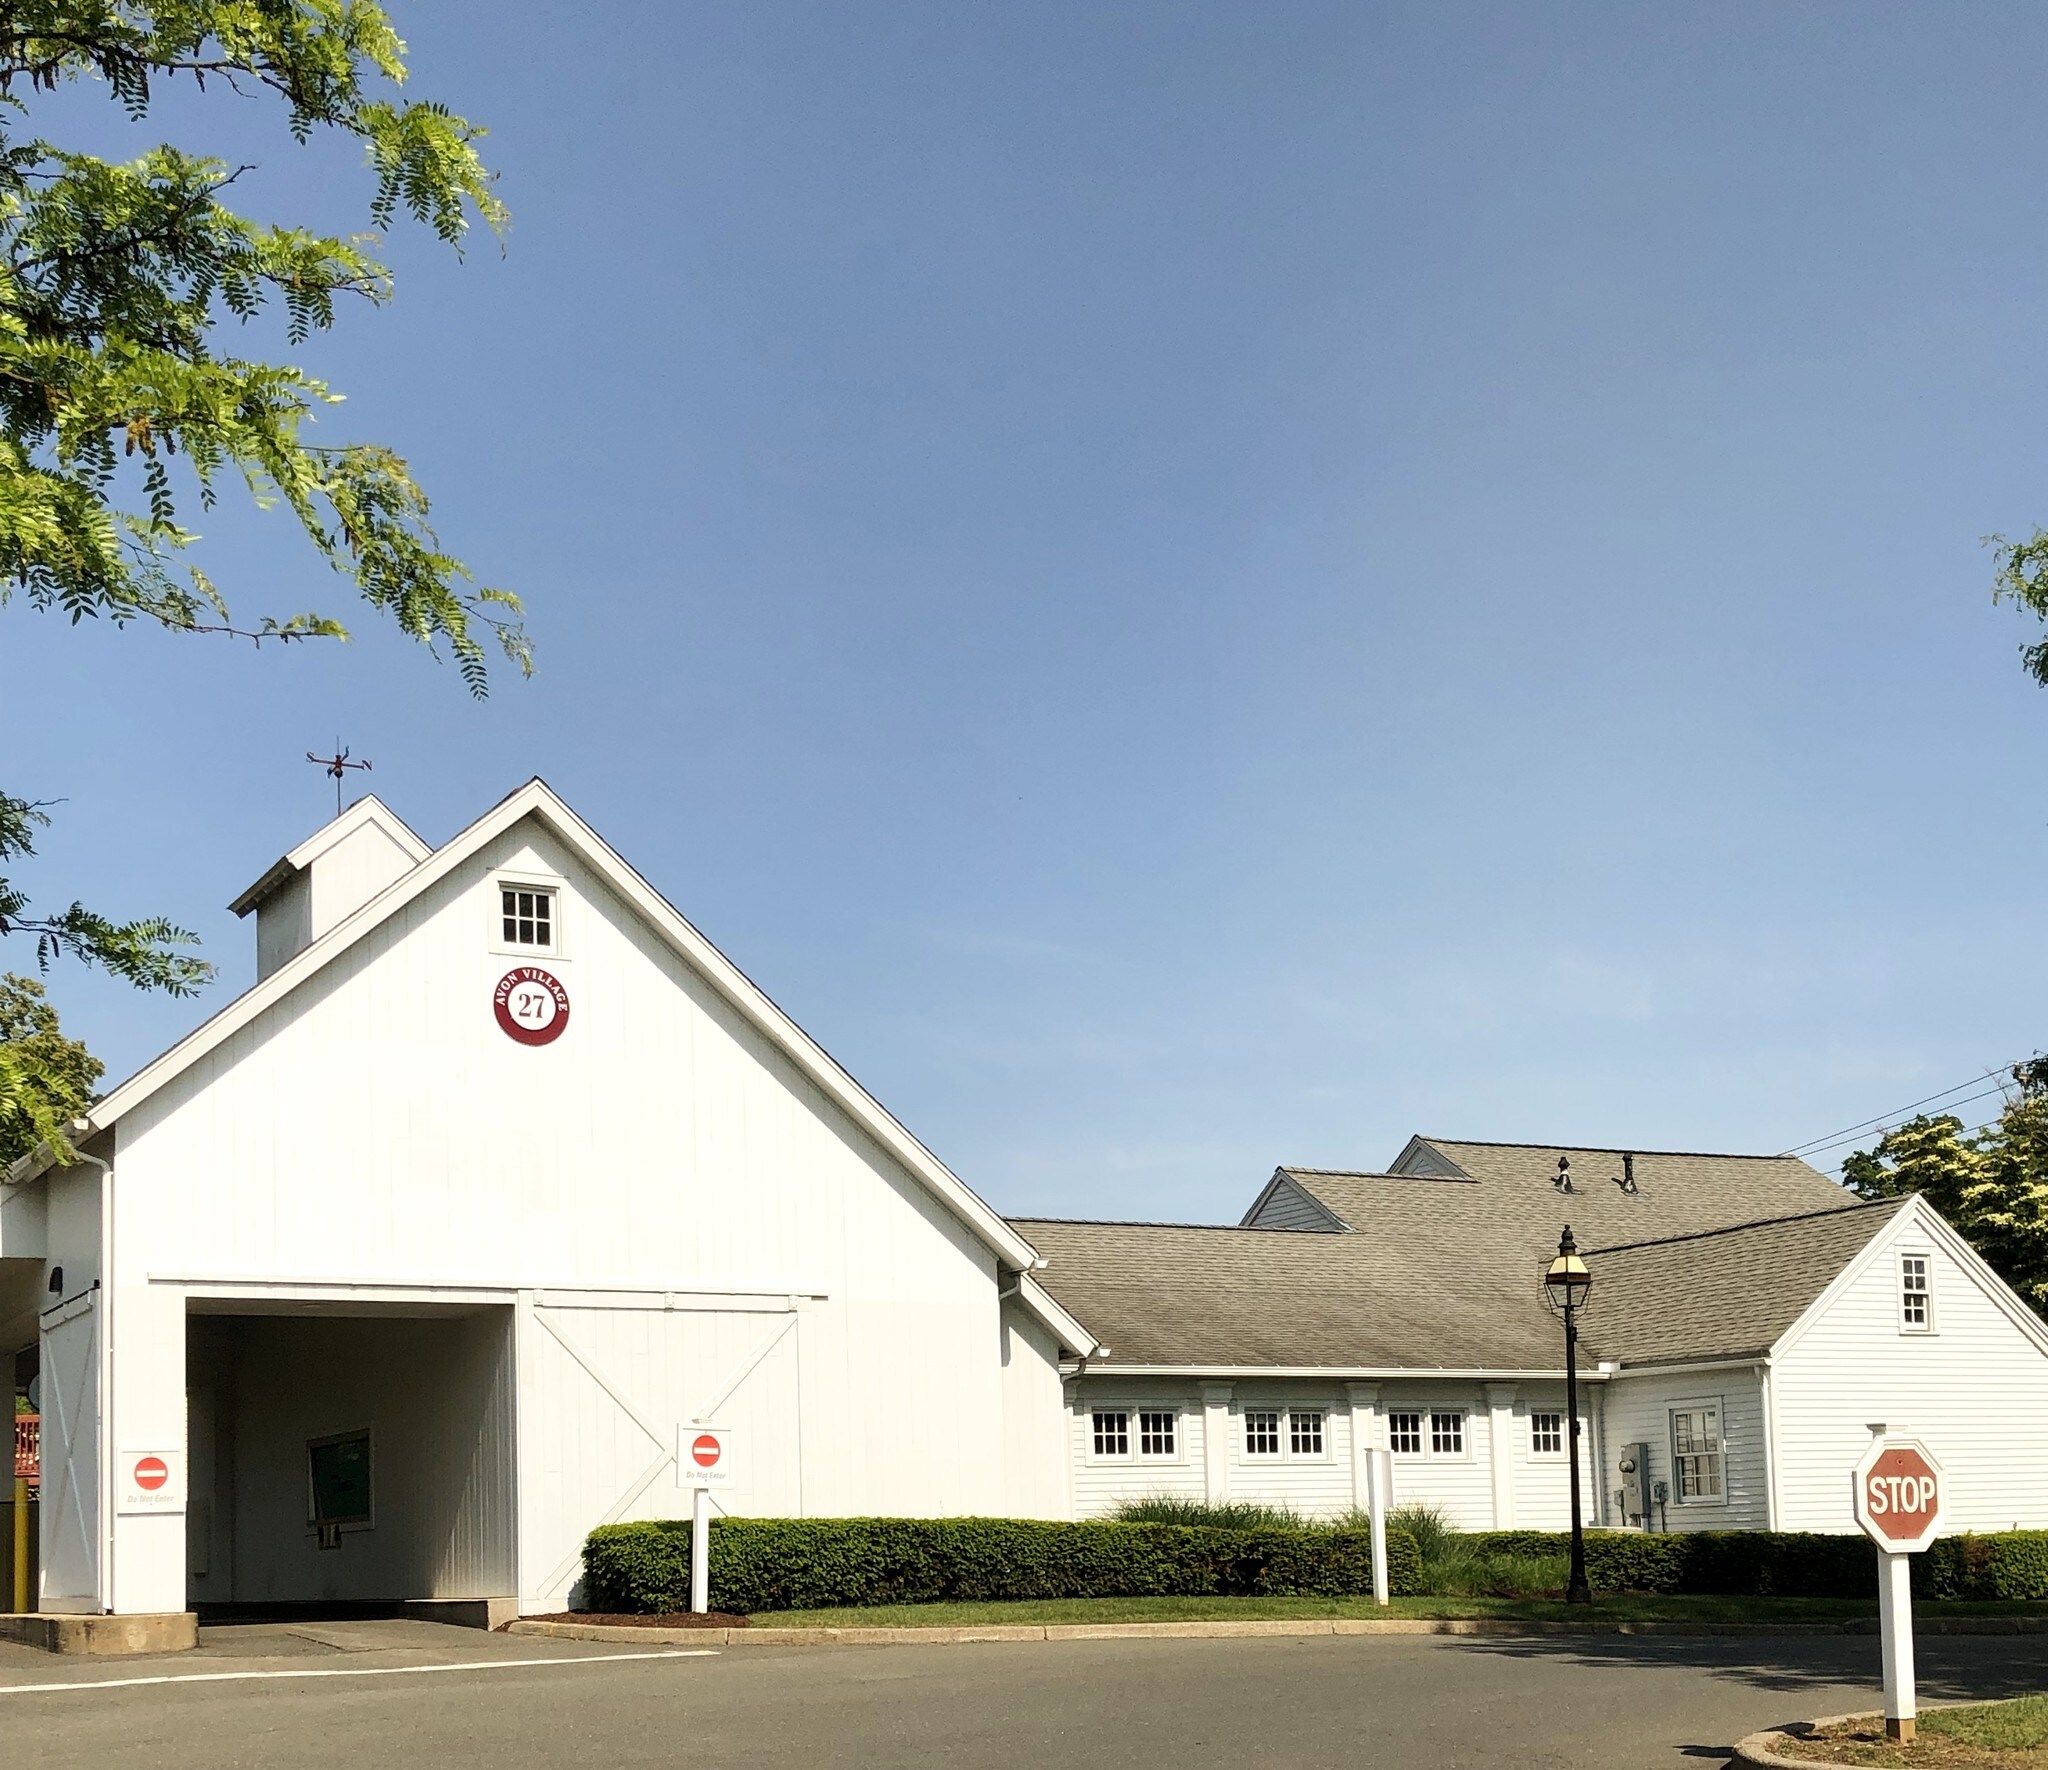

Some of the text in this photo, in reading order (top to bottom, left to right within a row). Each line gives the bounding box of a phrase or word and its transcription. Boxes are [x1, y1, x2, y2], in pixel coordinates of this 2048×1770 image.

[495, 969, 568, 1012] AVON VILLAGE
[518, 993, 546, 1019] 27
[1869, 1476, 1936, 1515] STOP
